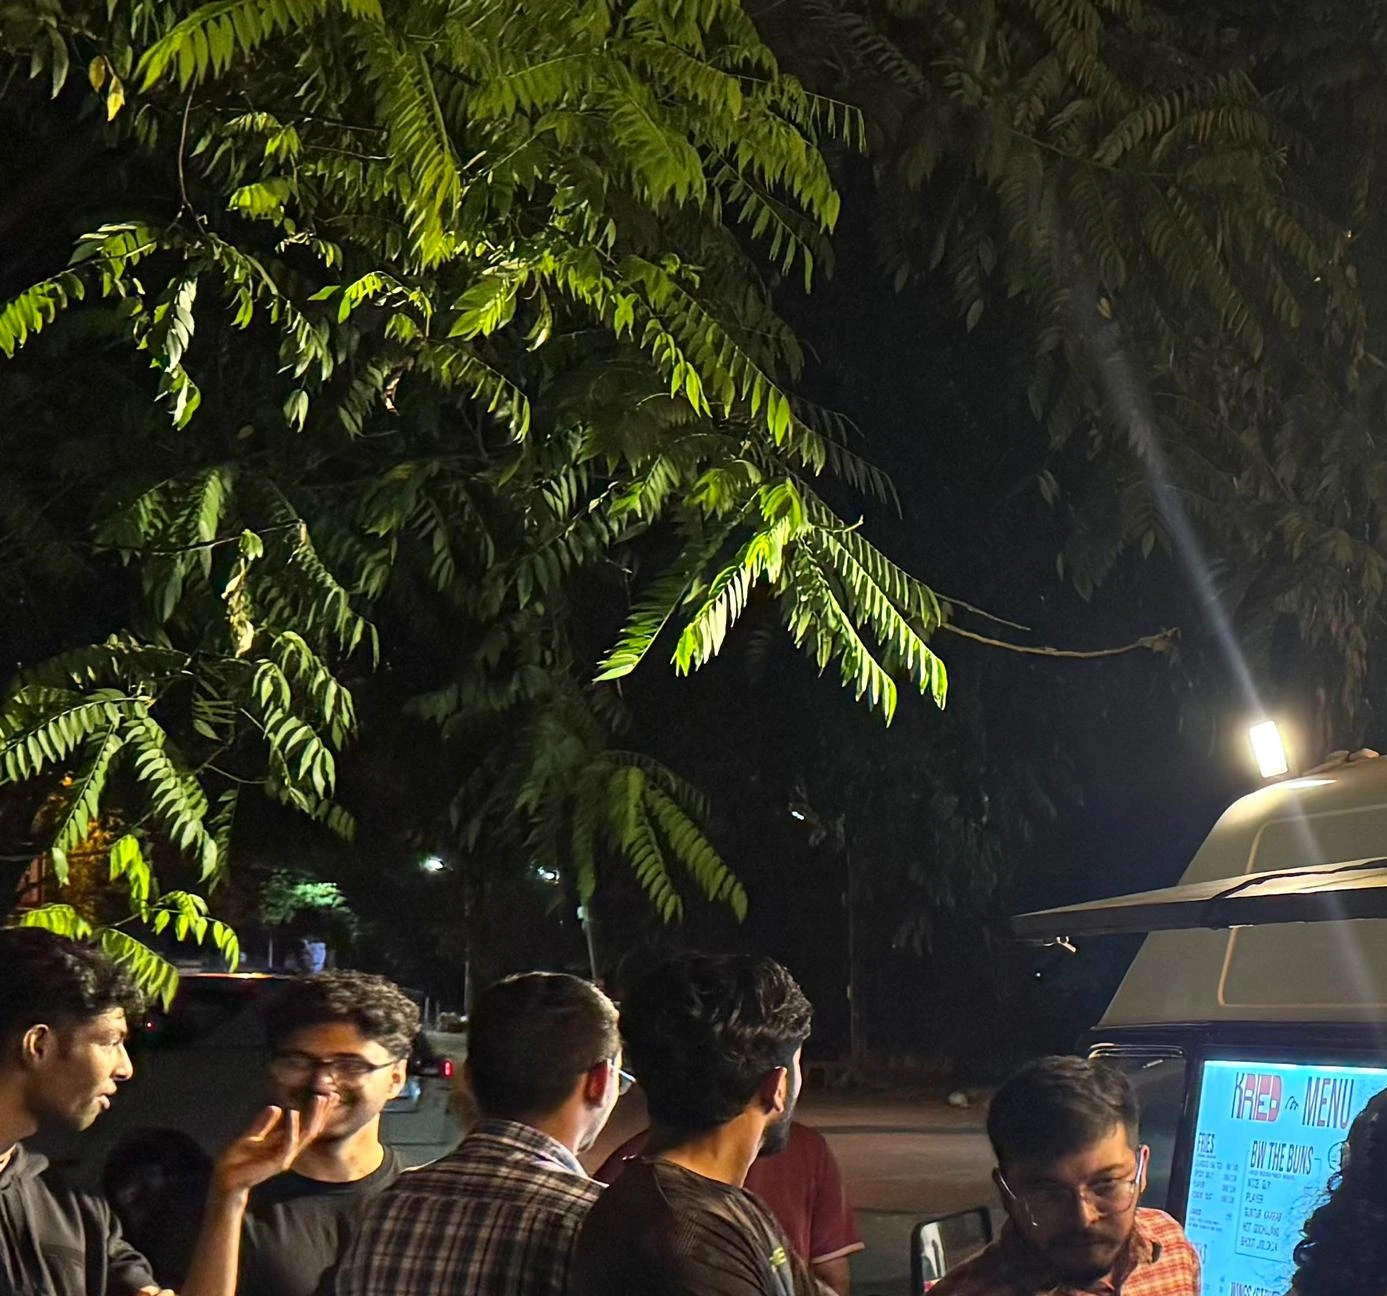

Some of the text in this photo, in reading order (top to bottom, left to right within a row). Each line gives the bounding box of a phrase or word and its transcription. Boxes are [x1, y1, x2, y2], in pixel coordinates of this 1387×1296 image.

[1231, 1071, 1355, 1128] KRIED MENU
[1267, 1142, 1287, 1172] THE
[1286, 1144, 1314, 1175] BUNS
